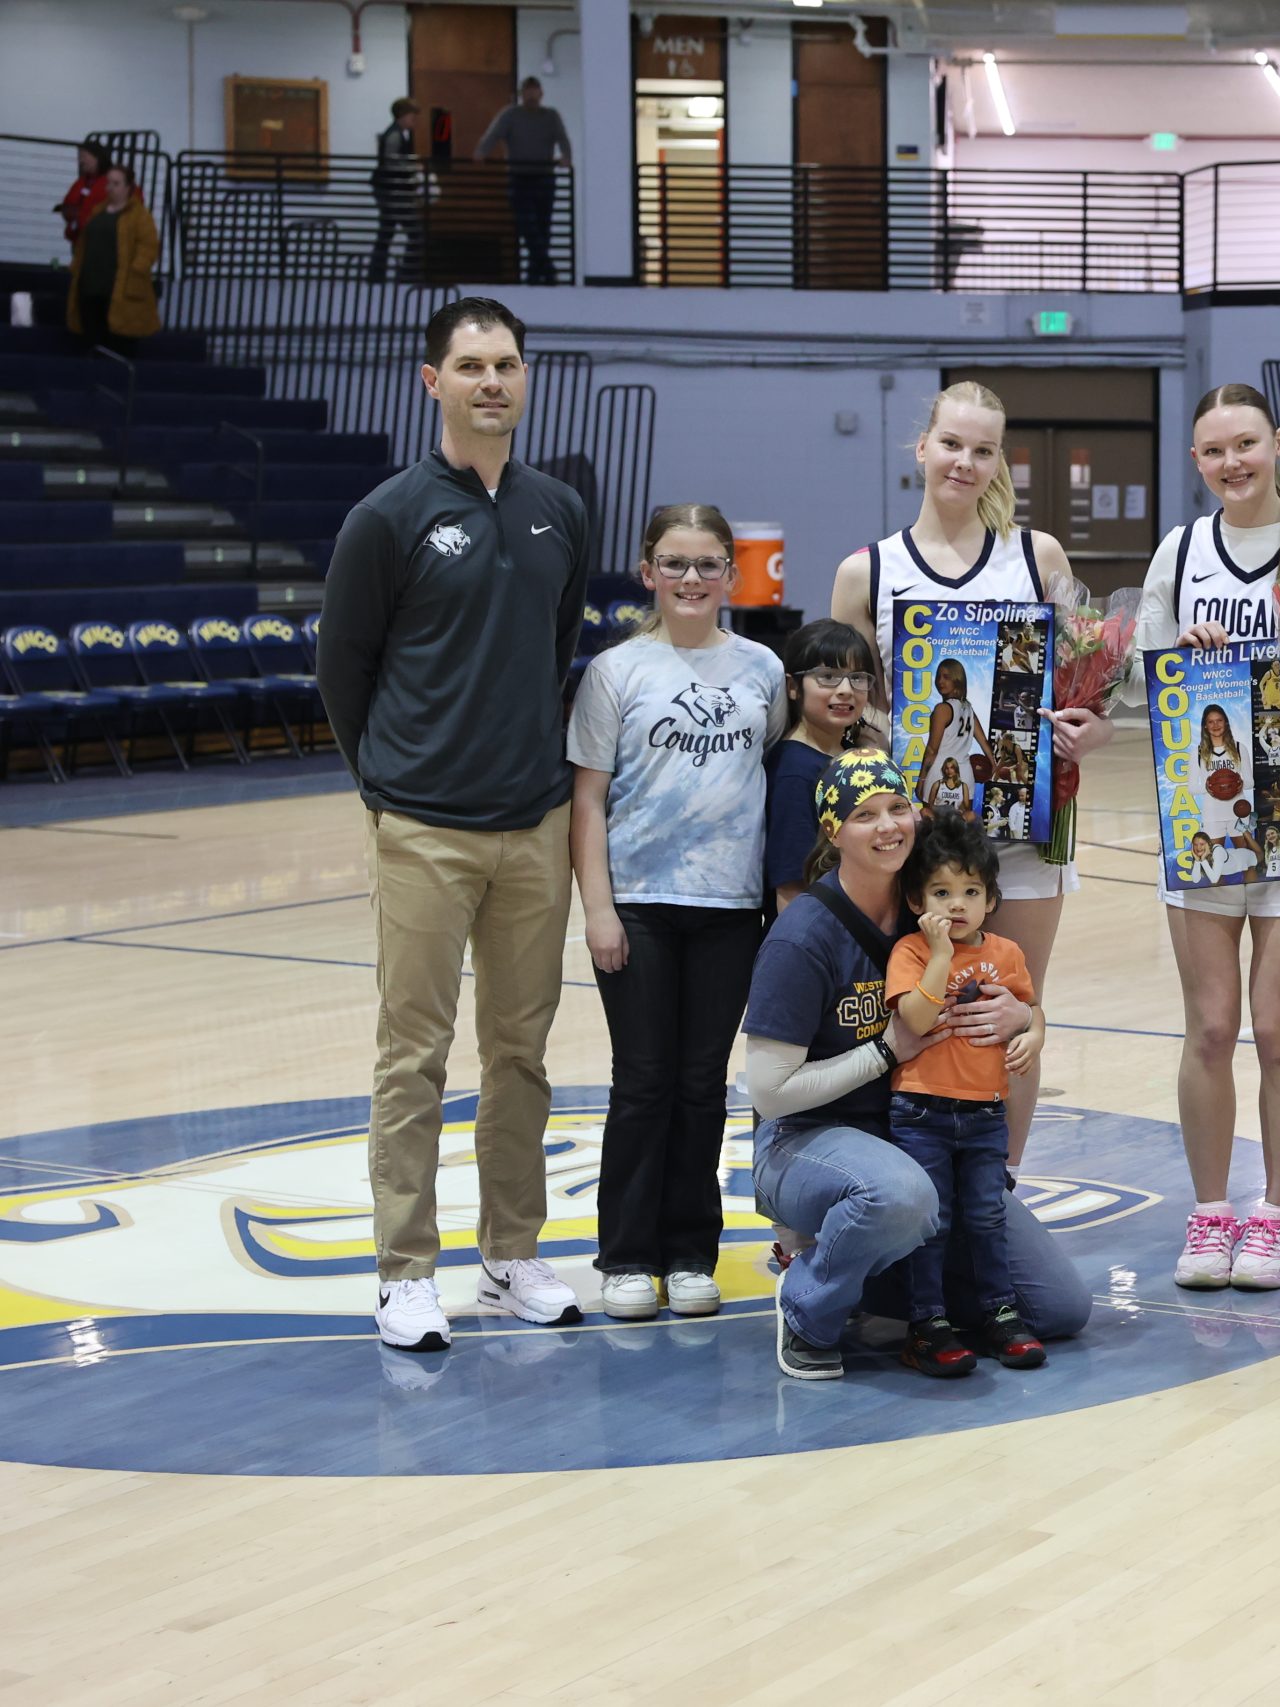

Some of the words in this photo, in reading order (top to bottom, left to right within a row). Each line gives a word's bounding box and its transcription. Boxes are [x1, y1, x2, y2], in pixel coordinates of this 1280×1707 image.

[653, 36, 705, 55] MEN
[935, 602, 958, 621] Zo
[949, 626, 980, 636] WNCC
[925, 636, 957, 646] Cougar
[961, 637, 1004, 647] Women's
[939, 647, 989, 657] Basketball
[1190, 644, 1233, 666] Ruth
[1202, 669, 1233, 680] WNCC
[1179, 682, 1213, 694] Cougar
[1215, 677, 1258, 689] Women's
[1195, 689, 1244, 701] Basketball
[957, 716, 972, 737] 24
[1017, 718, 1026, 727] 24
[648, 716, 754, 767] Cougars
[941, 791, 961, 800] COUGARS
[1271, 862, 1277, 872] 5
[947, 965, 975, 991] UCKY
